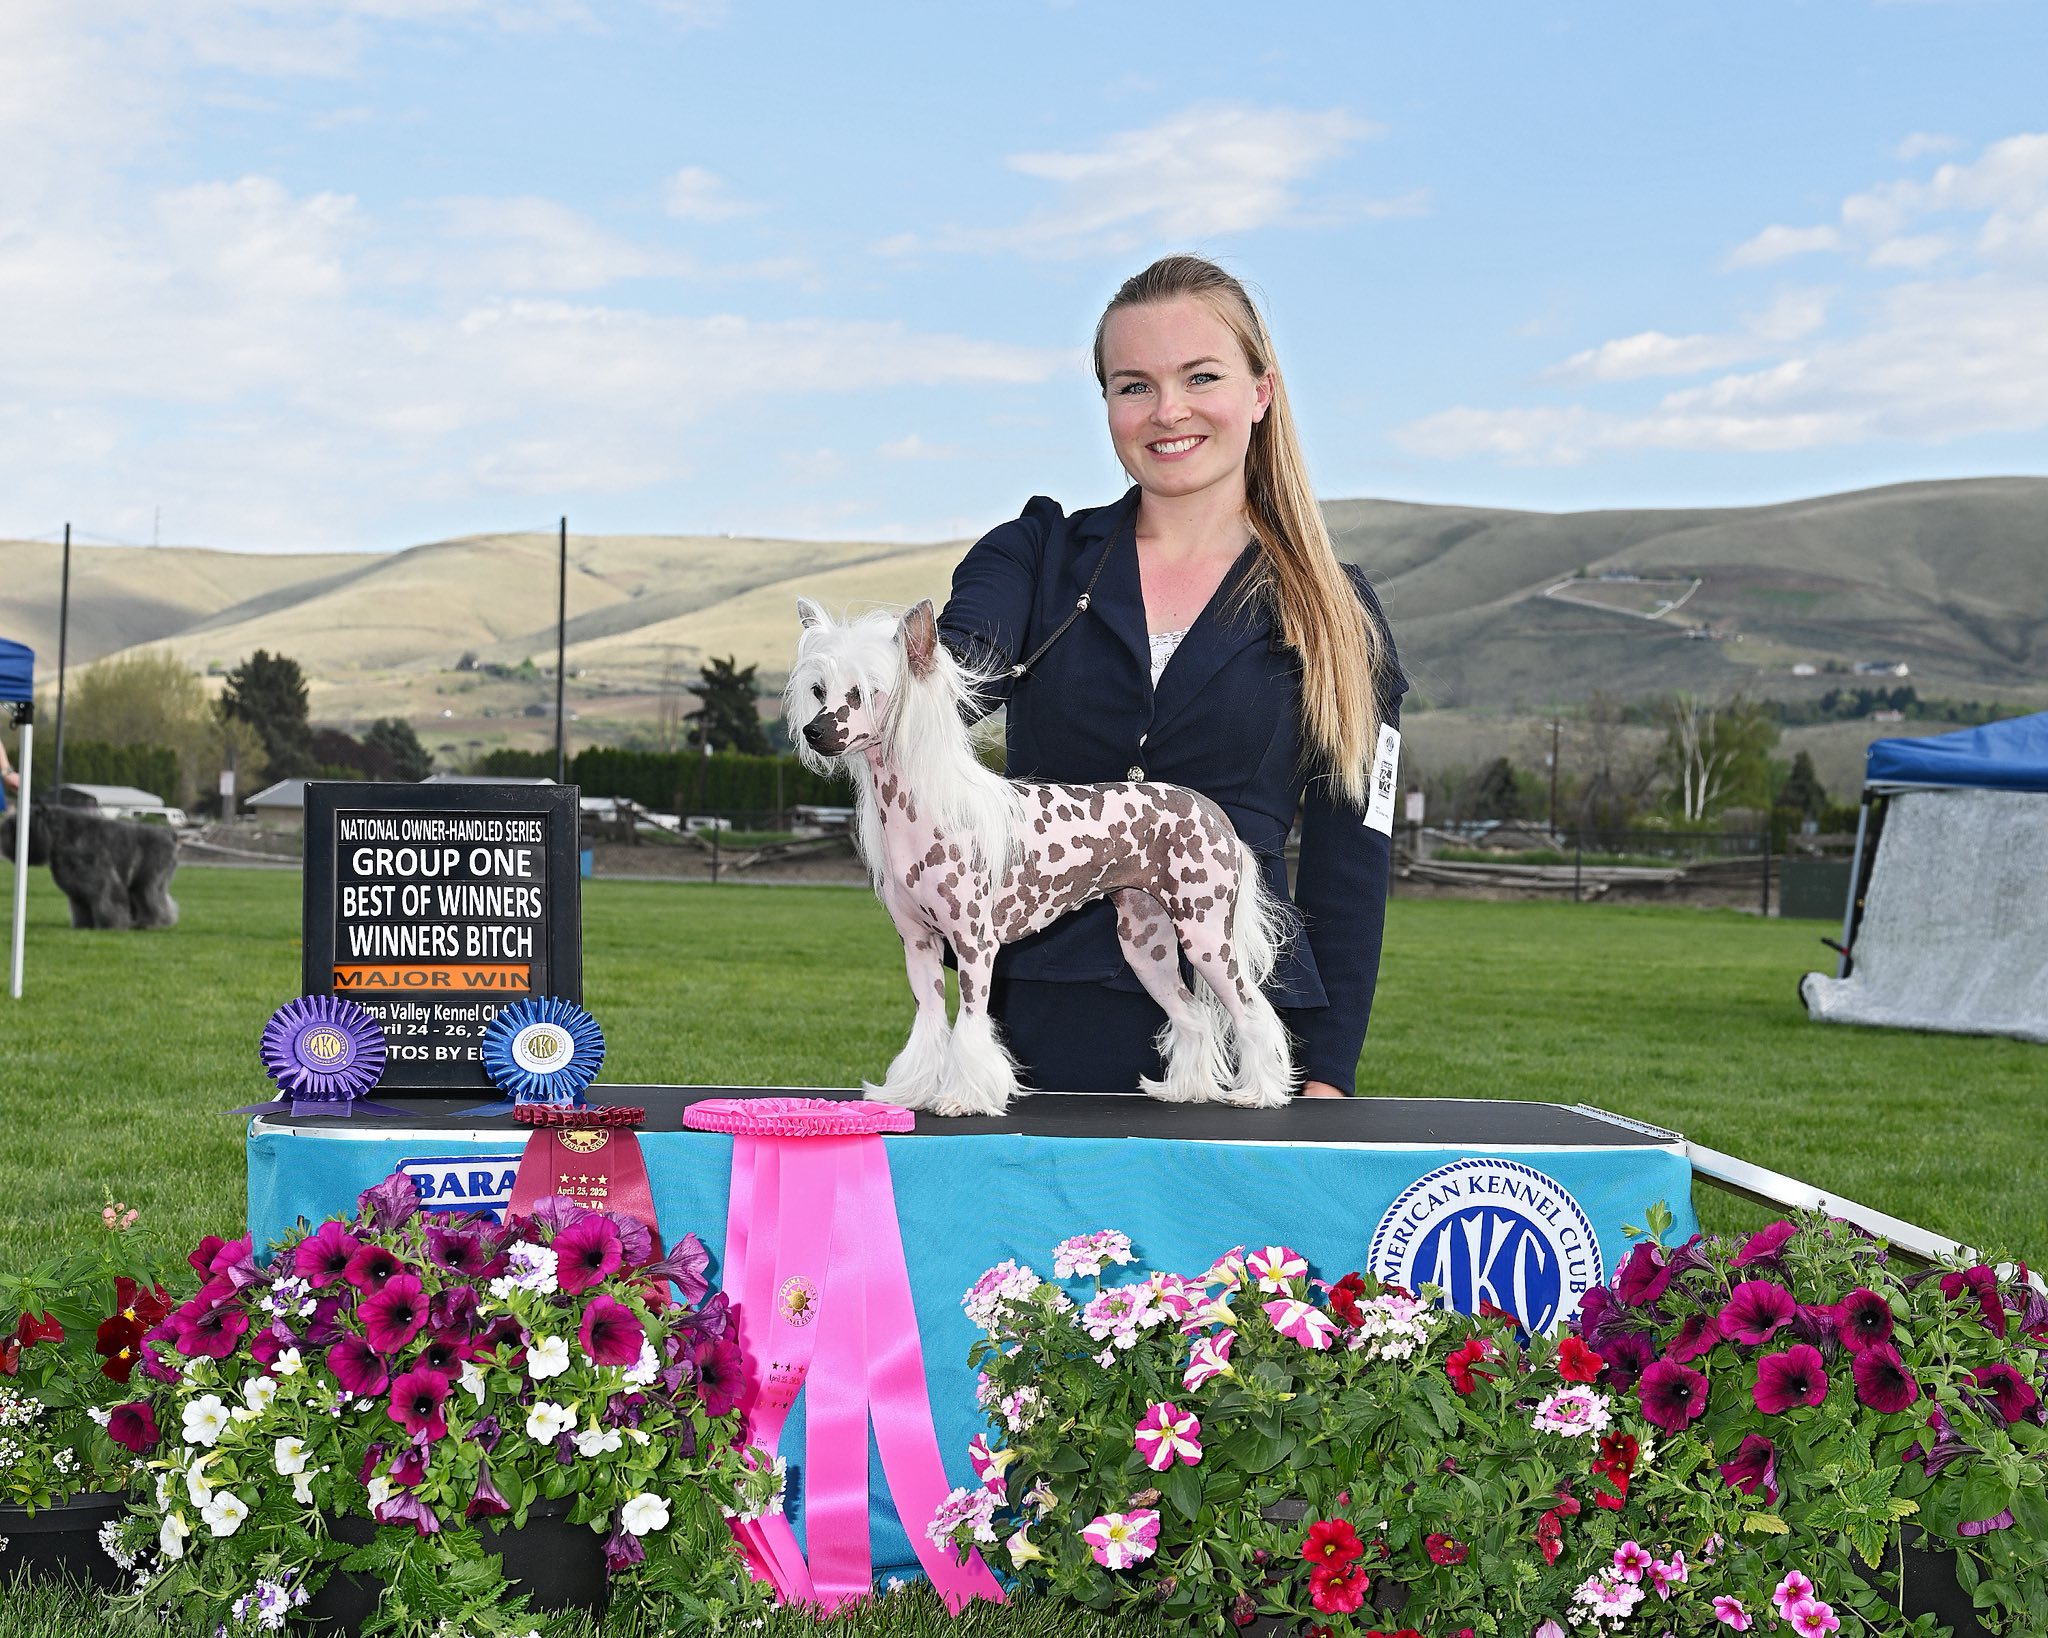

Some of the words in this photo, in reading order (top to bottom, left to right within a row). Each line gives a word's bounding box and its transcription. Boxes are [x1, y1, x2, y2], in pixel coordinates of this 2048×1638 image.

[341, 819, 400, 841] NATIONAL
[401, 819, 502, 842] OWNER-HANDLED
[505, 820, 542, 842] SERIES
[352, 848, 460, 877] GROUP
[469, 848, 532, 878] ONE
[343, 885, 396, 917] BEST
[401, 885, 431, 916] OF
[437, 886, 542, 918] WINNERS
[348, 925, 460, 957] WINNERS
[466, 926, 532, 957] BITCH
[334, 971, 451, 986] MAJOR
[462, 971, 530, 988] WIN
[390, 1003, 431, 1024] Valley
[434, 1004, 479, 1021] Kennel
[379, 1023, 402, 1035] ril
[406, 1024, 429, 1036] 24
[444, 1025, 472, 1038] 26,
[312, 1034, 340, 1058] AKC
[385, 1045, 429, 1060] TOS
[435, 1047, 462, 1061] BY
[529, 1035, 557, 1058] AKC
[411, 1170, 517, 1199] BARA
[557, 1185, 575, 1196] April
[576, 1186, 588, 1197] 25,
[589, 1187, 608, 1197] 2026
[1383, 1180, 1461, 1284] MERICAN
[1468, 1175, 1562, 1227] KENNEL
[1559, 1227, 1587, 1294] CLUB
[1430, 1211, 1552, 1338] AKC
